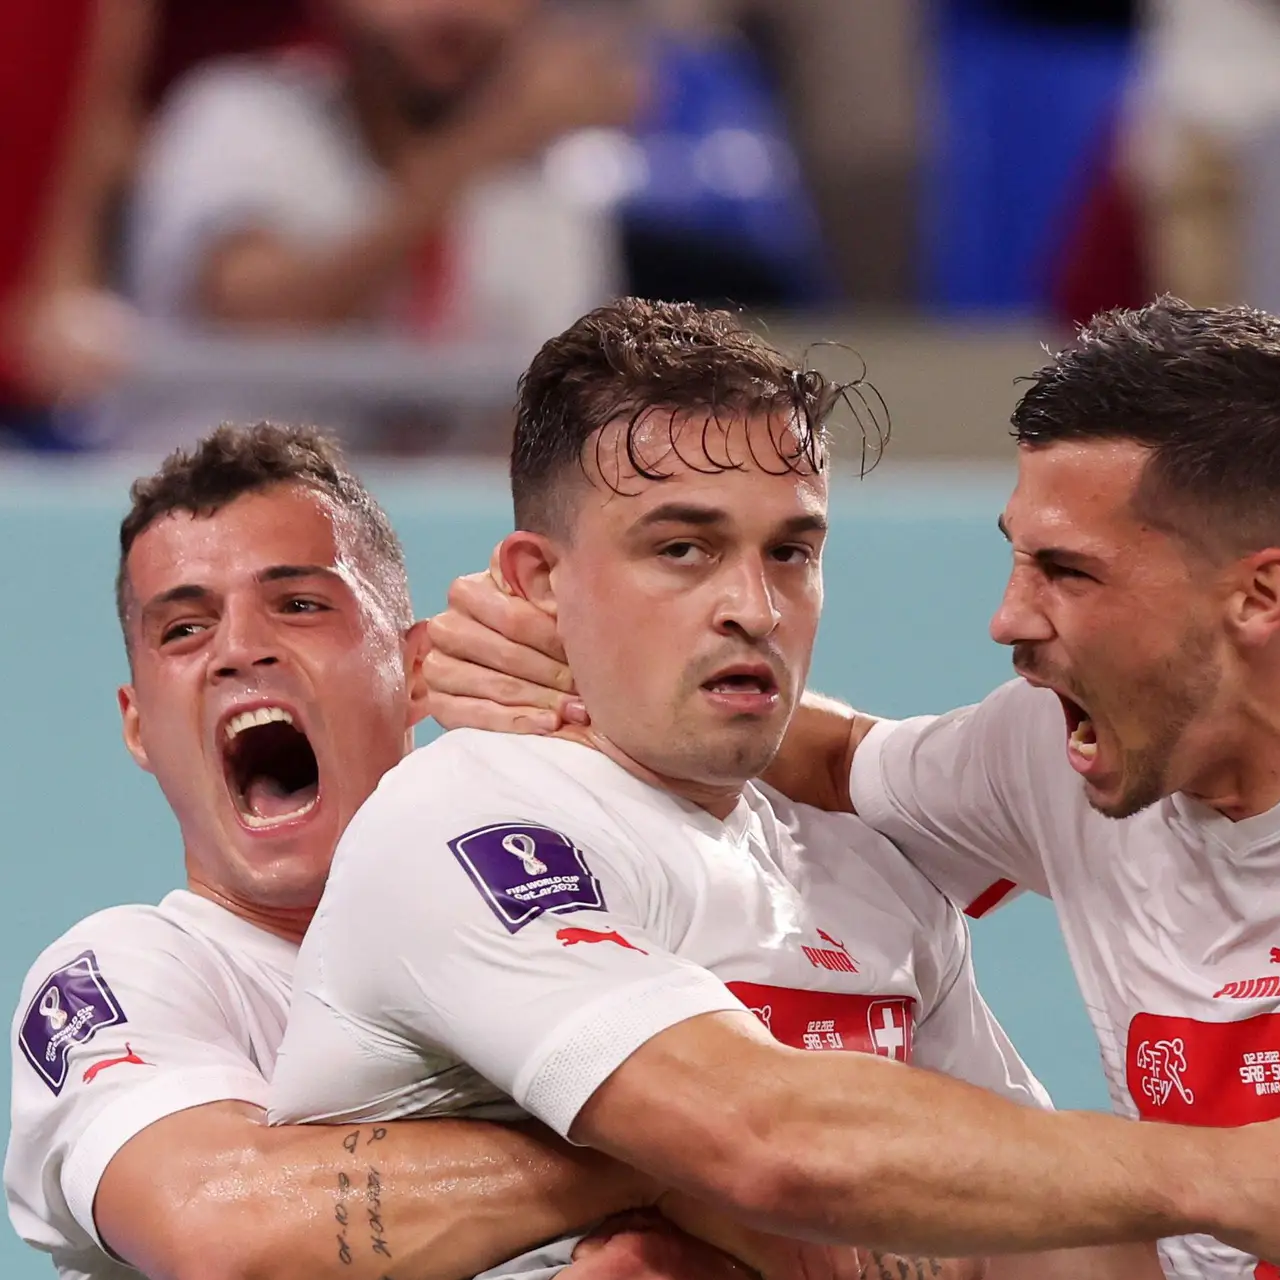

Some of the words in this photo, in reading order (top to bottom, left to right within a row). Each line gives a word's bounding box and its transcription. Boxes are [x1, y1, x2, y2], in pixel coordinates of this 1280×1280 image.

[506, 885, 529, 895] FIFA
[528, 876, 562, 890] WORLD
[801, 945, 860, 974] PUMA
[51, 1017, 79, 1043] WORLD
[76, 1005, 95, 1017] CUP
